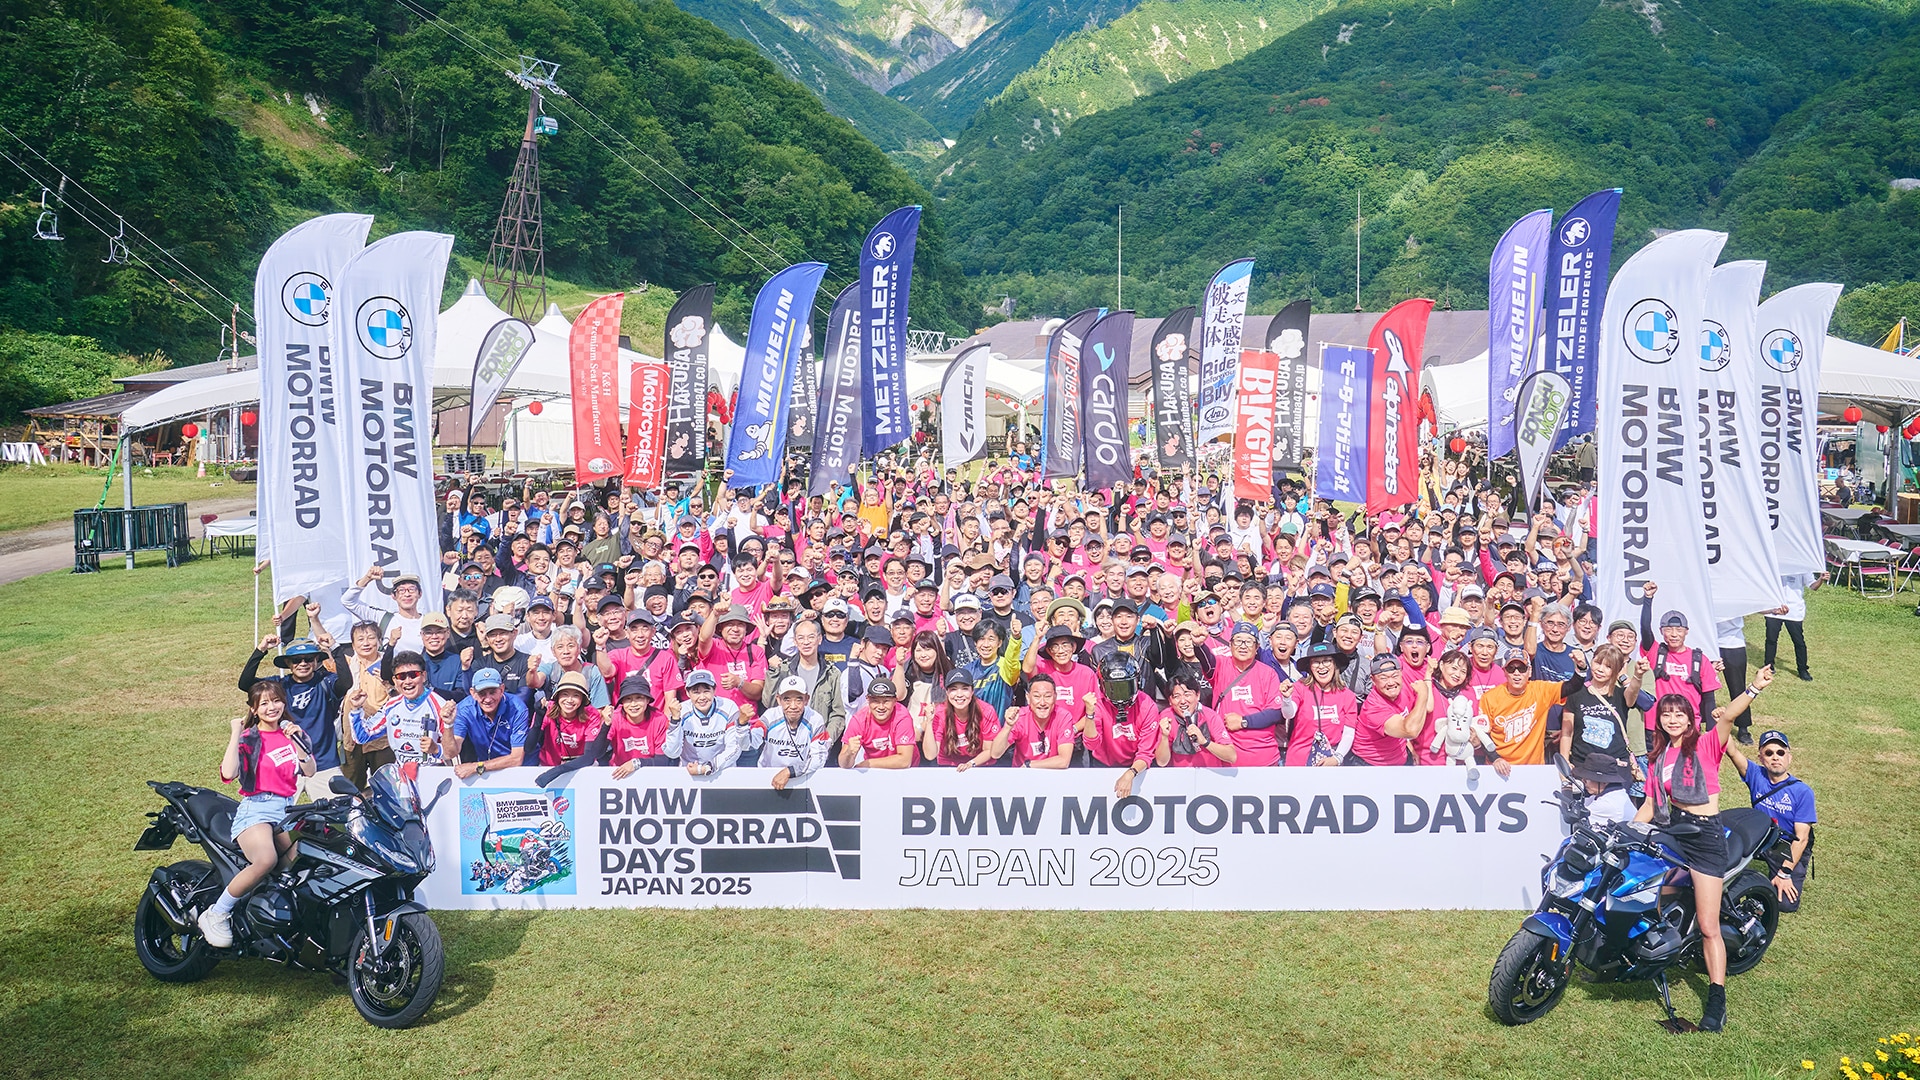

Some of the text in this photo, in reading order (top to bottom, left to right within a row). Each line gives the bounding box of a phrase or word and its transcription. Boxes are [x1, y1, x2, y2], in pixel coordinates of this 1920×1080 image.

[1210, 283, 1245, 307] 被って
[1211, 305, 1243, 325] 走って
[1509, 245, 1529, 377] MICHELIN
[1577, 251, 1593, 359] INDEPENDENCE
[478, 323, 519, 384] BONSAI
[496, 336, 526, 380] MOTO
[755, 288, 794, 417] MICHELIN
[871, 264, 892, 435] METZELER
[888, 263, 901, 433] SHARING INDEPENDENCE
[1203, 357, 1236, 380] Ride
[1205, 325, 1241, 347] 体感
[590, 320, 601, 446] Premium Seat Manufacturer
[602, 371, 611, 396] K&H
[668, 348, 692, 423] HAKUBA
[694, 354, 708, 459] www.hakuba47.co.jp
[964, 364, 974, 433] TAICHI
[1159, 361, 1180, 426] HAKUBA
[1178, 366, 1194, 458] www.hakuba47.co.jp
[1202, 382, 1233, 406] Buy
[1273, 359, 1291, 428] HAKUBA
[1292, 364, 1306, 463] www.hakuba47.co.jp
[1520, 376, 1555, 447] BONSAI
[1538, 390, 1565, 440] MOTO
[286, 343, 321, 529] MOTORRAD
[394, 383, 418, 479] BMW
[635, 369, 659, 475] Motorcyclist
[828, 395, 855, 468] Motors
[1092, 373, 1124, 466] cardo
[1334, 359, 1356, 494] モーターマガジン社
[1382, 376, 1401, 495] alpinestars
[1656, 386, 1684, 486] BMW
[1716, 390, 1741, 468] BMW
[1786, 388, 1802, 455] BMW
[360, 378, 401, 596] MOTORRAD
[1761, 385, 1781, 531] MOTORRAD
[1622, 384, 1651, 606] MOTORRAD
[693, 740, 717, 748] GS
[700, 729, 726, 739] Motorra
[768, 737, 785, 746] BMW
[777, 748, 799, 757] GS
[497, 805, 540, 813] MOTORRAD
[600, 788, 698, 815] BMW
[600, 817, 823, 844] MOTORRAD
[902, 793, 1528, 835] BMW MOTORRAD DAYS
[600, 847, 696, 874] DAYS
[601, 877, 752, 895] JAPAN 2025
[899, 847, 1220, 886] JAPAN 2025
